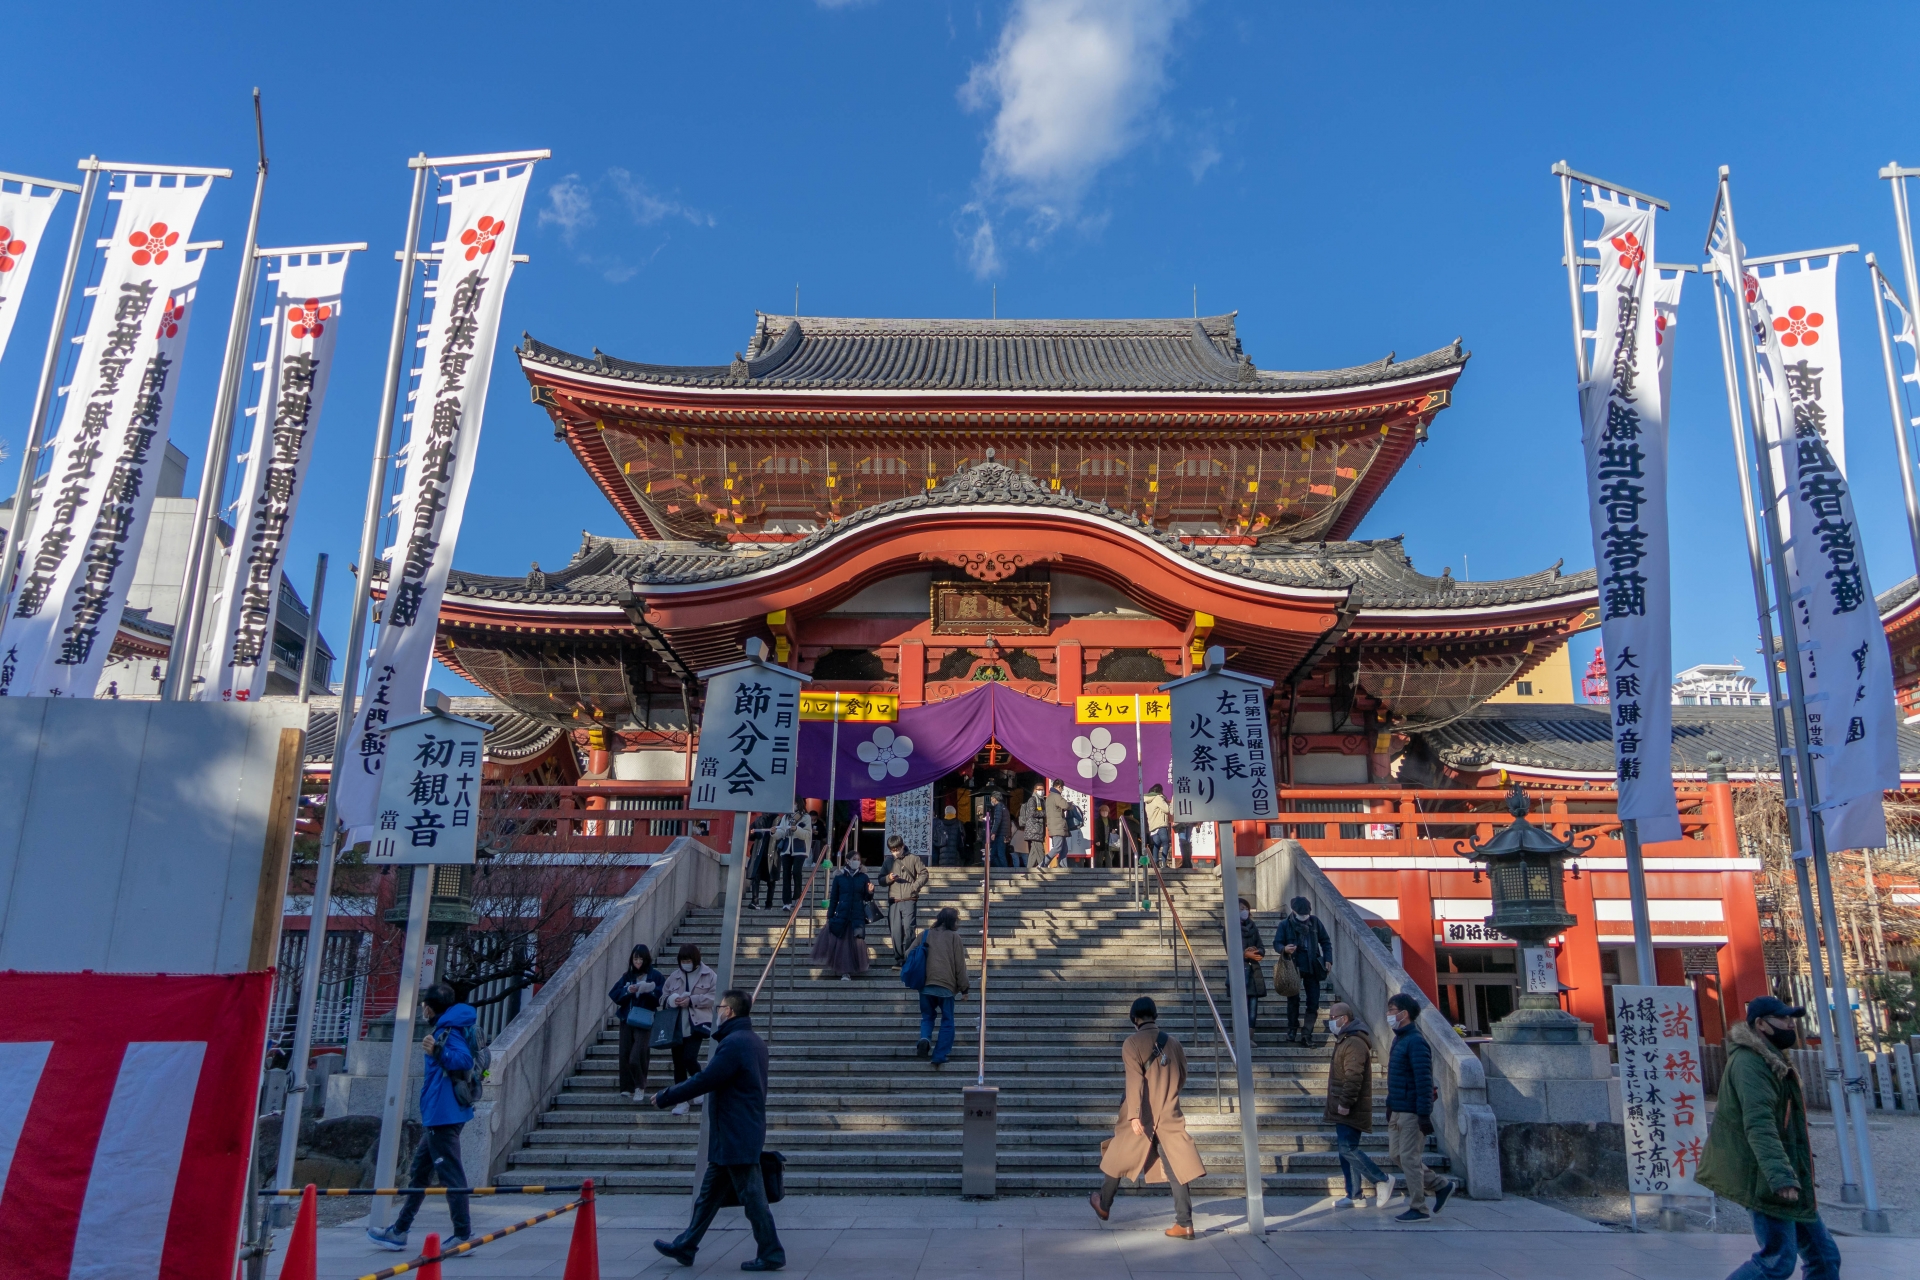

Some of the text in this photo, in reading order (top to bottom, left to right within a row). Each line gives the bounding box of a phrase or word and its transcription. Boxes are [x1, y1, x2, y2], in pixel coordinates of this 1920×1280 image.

[723, 682, 772, 796] 節分会
[770, 693, 794, 775] 二月三日
[802, 700, 827, 713] り口
[845, 698, 890, 716] 登り口
[1084, 700, 1129, 718] 登り口
[1216, 690, 1249, 780] 左義長
[404, 734, 456, 848] 初観音
[452, 741, 479, 827] 一月十八日
[697, 756, 719, 804] 當山
[1176, 776, 1193, 816] 當山
[1190, 713, 1218, 804] 火祭り
[375, 809, 400, 858] 當山
[1449, 924, 1508, 940] 初祈祷
[1617, 997, 1652, 1192] 布袋さまにお願いして下さい。
[1636, 997, 1671, 1192] 縁結びは本堂内左側の
[1658, 1002, 1703, 1178] 諸縁吉祥
